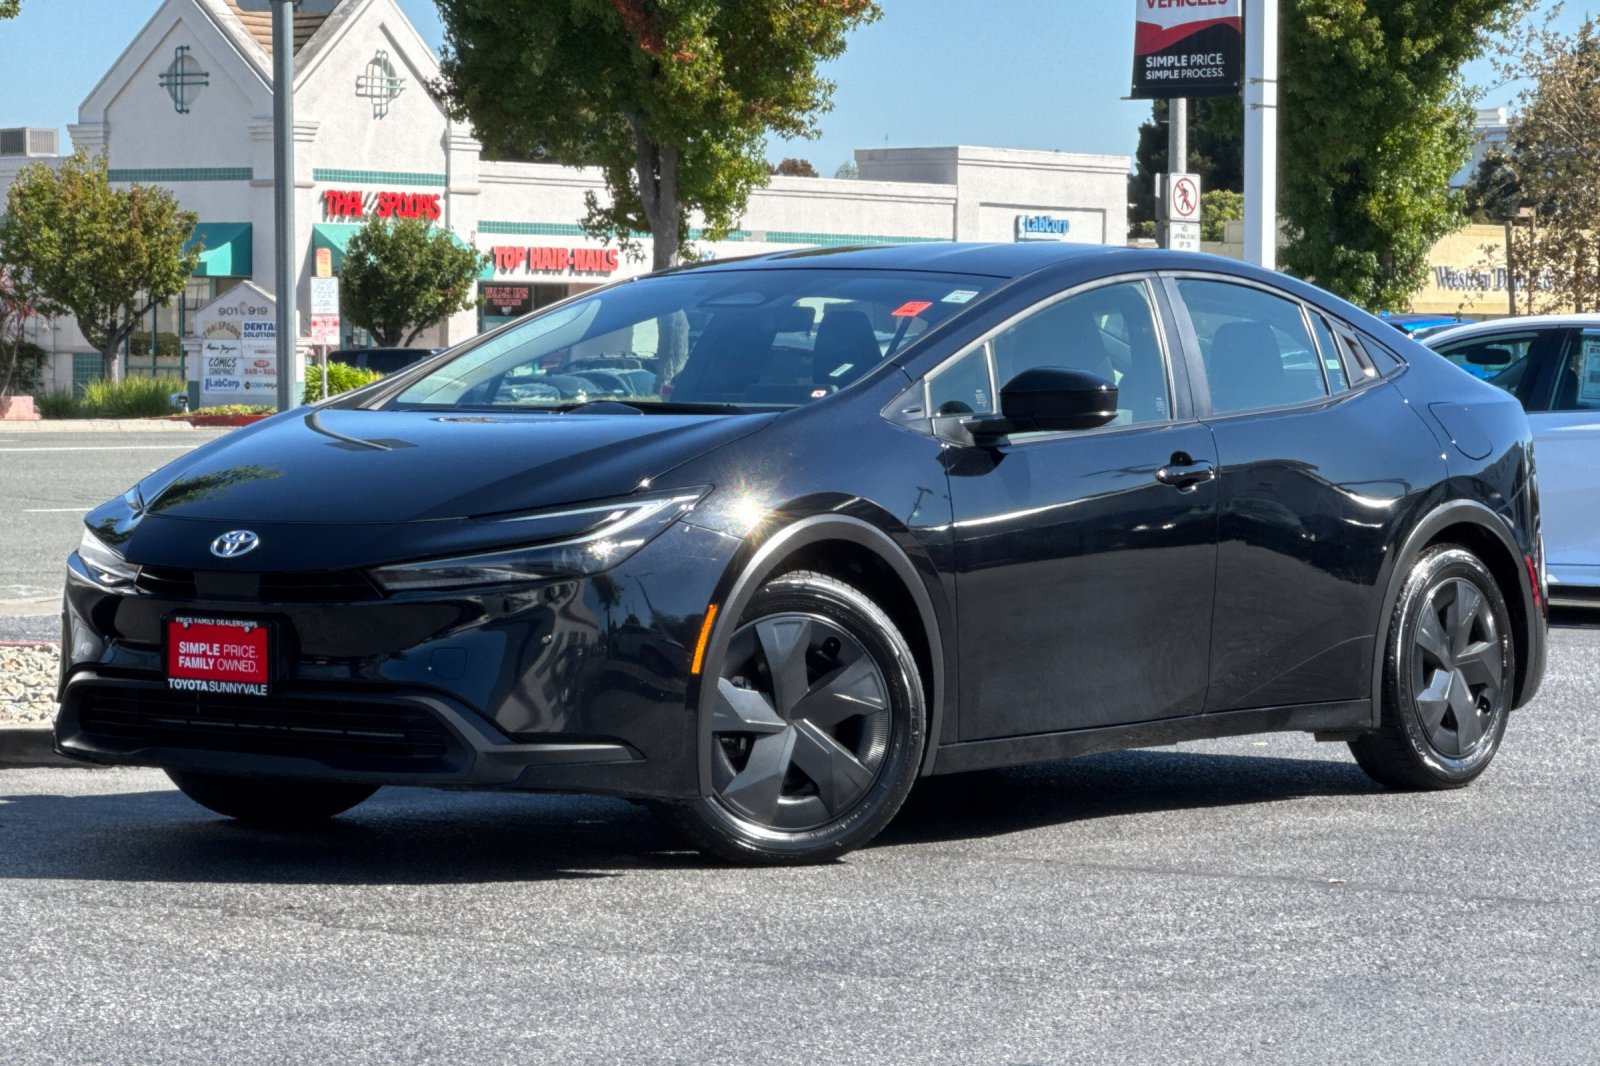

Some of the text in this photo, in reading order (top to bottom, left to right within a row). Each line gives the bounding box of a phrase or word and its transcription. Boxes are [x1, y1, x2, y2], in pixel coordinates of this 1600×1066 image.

[1146, 53, 1225, 68] SIMPLE PRICE.
[1146, 67, 1225, 80] SIMPLE PROCESS.
[325, 190, 441, 220] THAI SPOONS
[1025, 215, 1070, 236] LabCorp
[494, 246, 526, 270] TOP
[218, 306, 268, 316] 901 919
[243, 322, 275, 331] DENTA
[208, 357, 237, 368] COMICS
[209, 378, 240, 389] LabCorp
[175, 616, 258, 628] PRICE FAMILY DEALERSHIPS
[179, 640, 258, 659] SIMPLE PRICE.
[178, 656, 258, 673] FAMILY OWNED.
